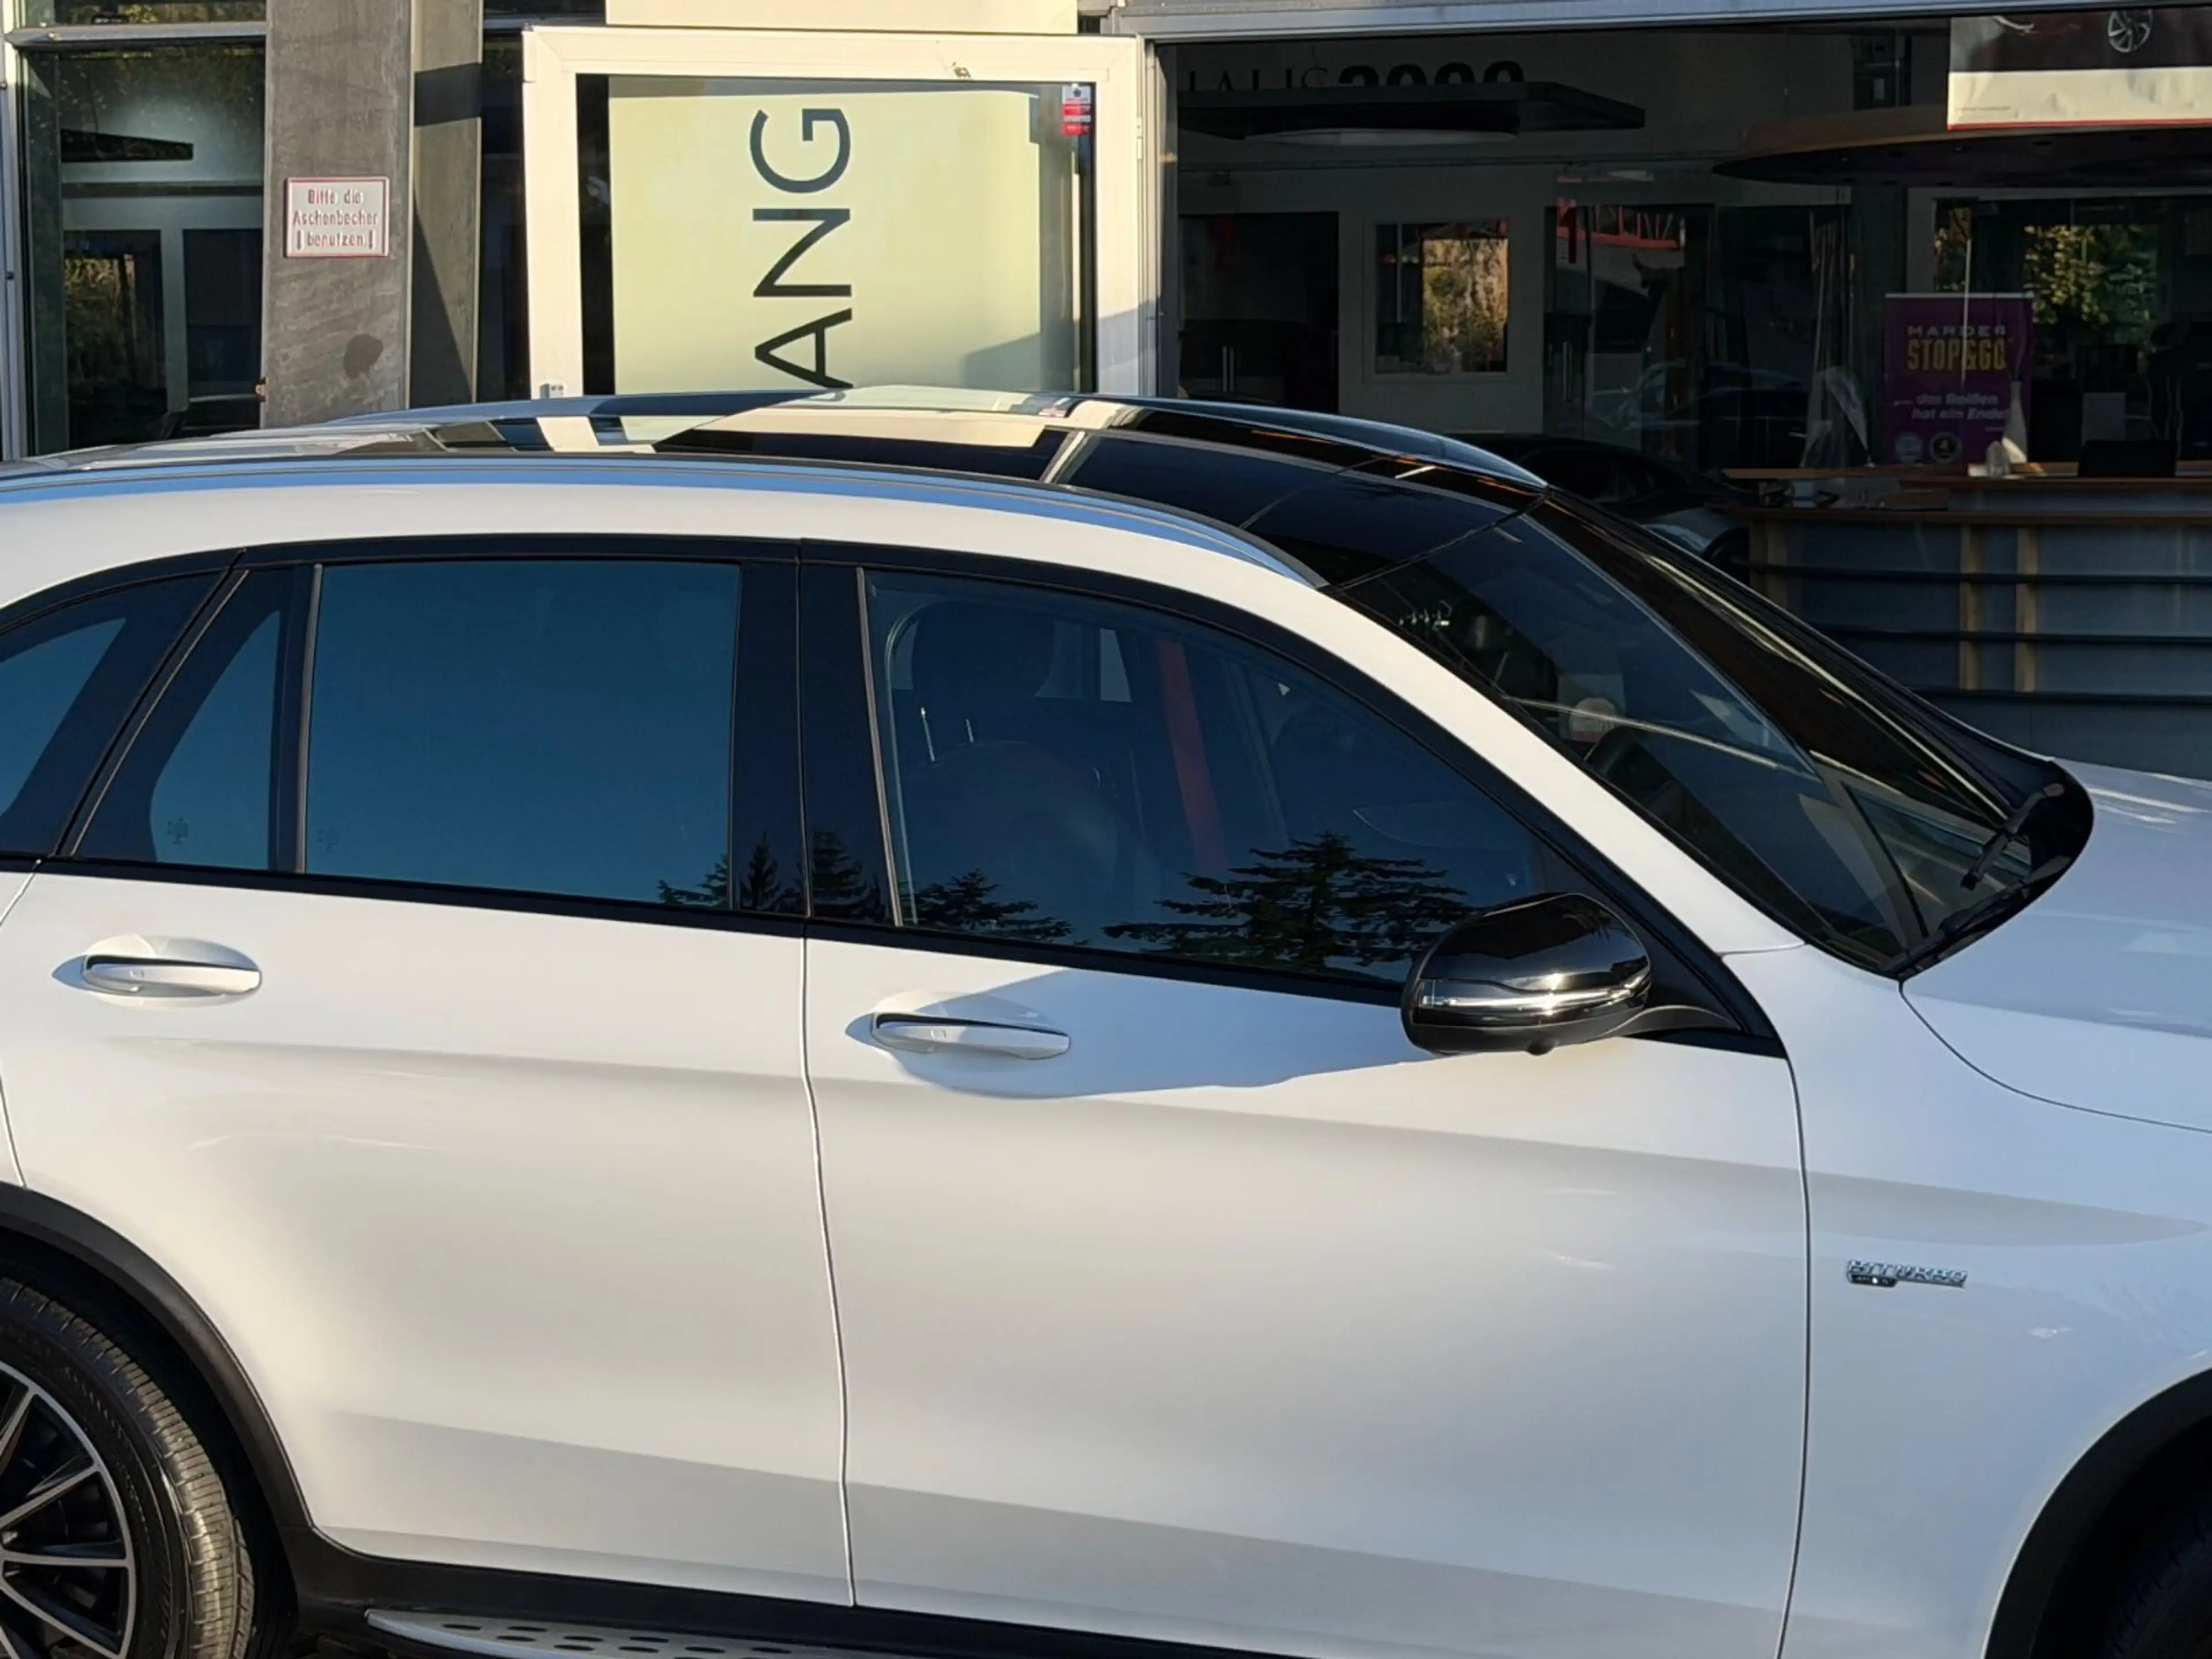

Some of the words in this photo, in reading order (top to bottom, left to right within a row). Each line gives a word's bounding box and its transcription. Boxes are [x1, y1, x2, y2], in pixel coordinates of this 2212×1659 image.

[308, 189, 337, 204] Bitte
[344, 188, 363, 204] die
[293, 210, 378, 226] Aschenbecher
